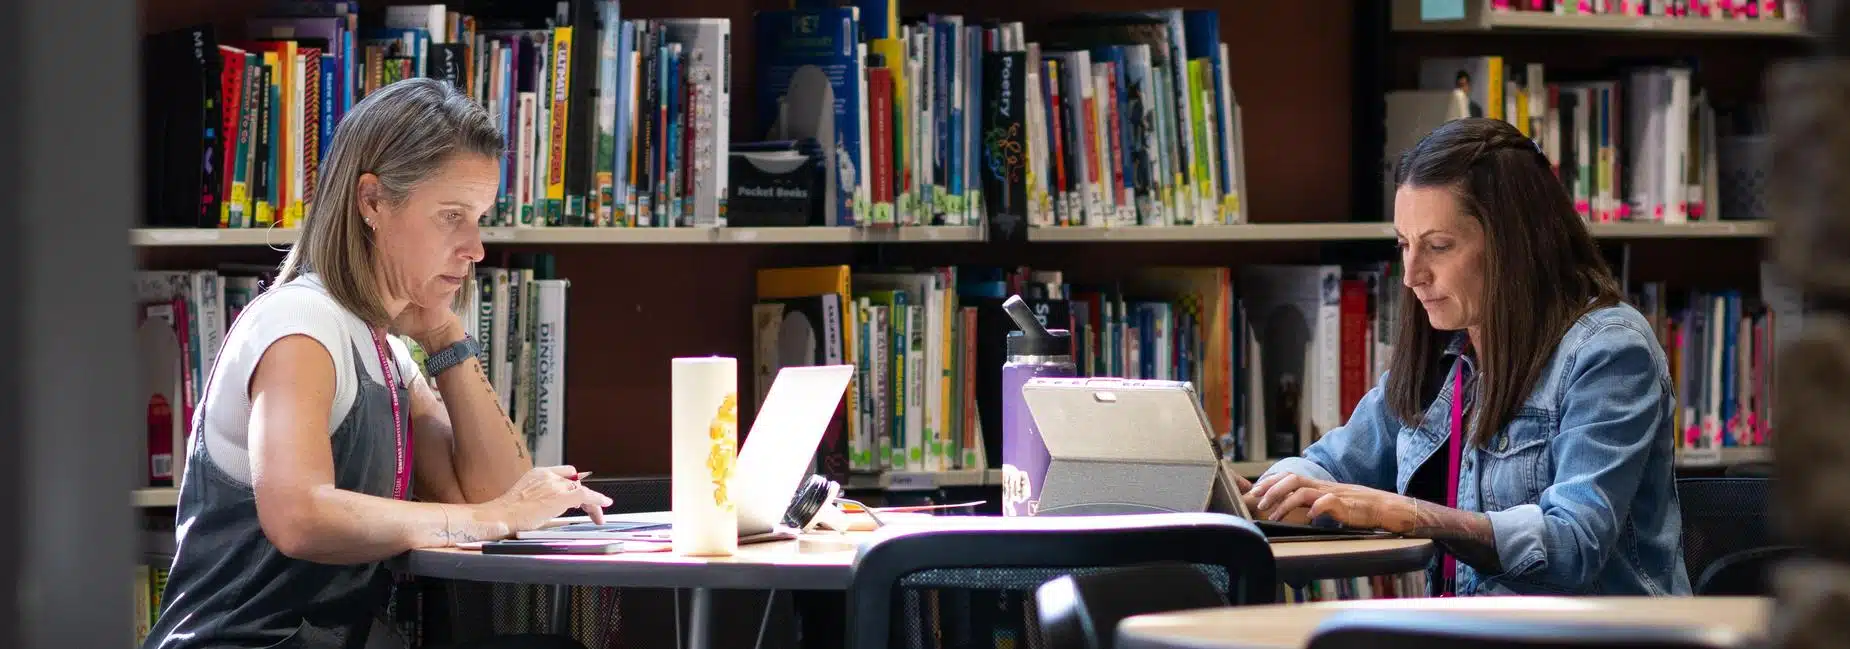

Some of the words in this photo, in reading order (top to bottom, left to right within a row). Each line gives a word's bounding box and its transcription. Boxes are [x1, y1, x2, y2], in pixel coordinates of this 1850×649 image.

[555, 49, 567, 101] ULTIMATE
[999, 56, 1013, 117] Poetry
[737, 186, 773, 197] Pocket
[776, 187, 808, 197] Books
[538, 323, 549, 437] DINOSAURS
